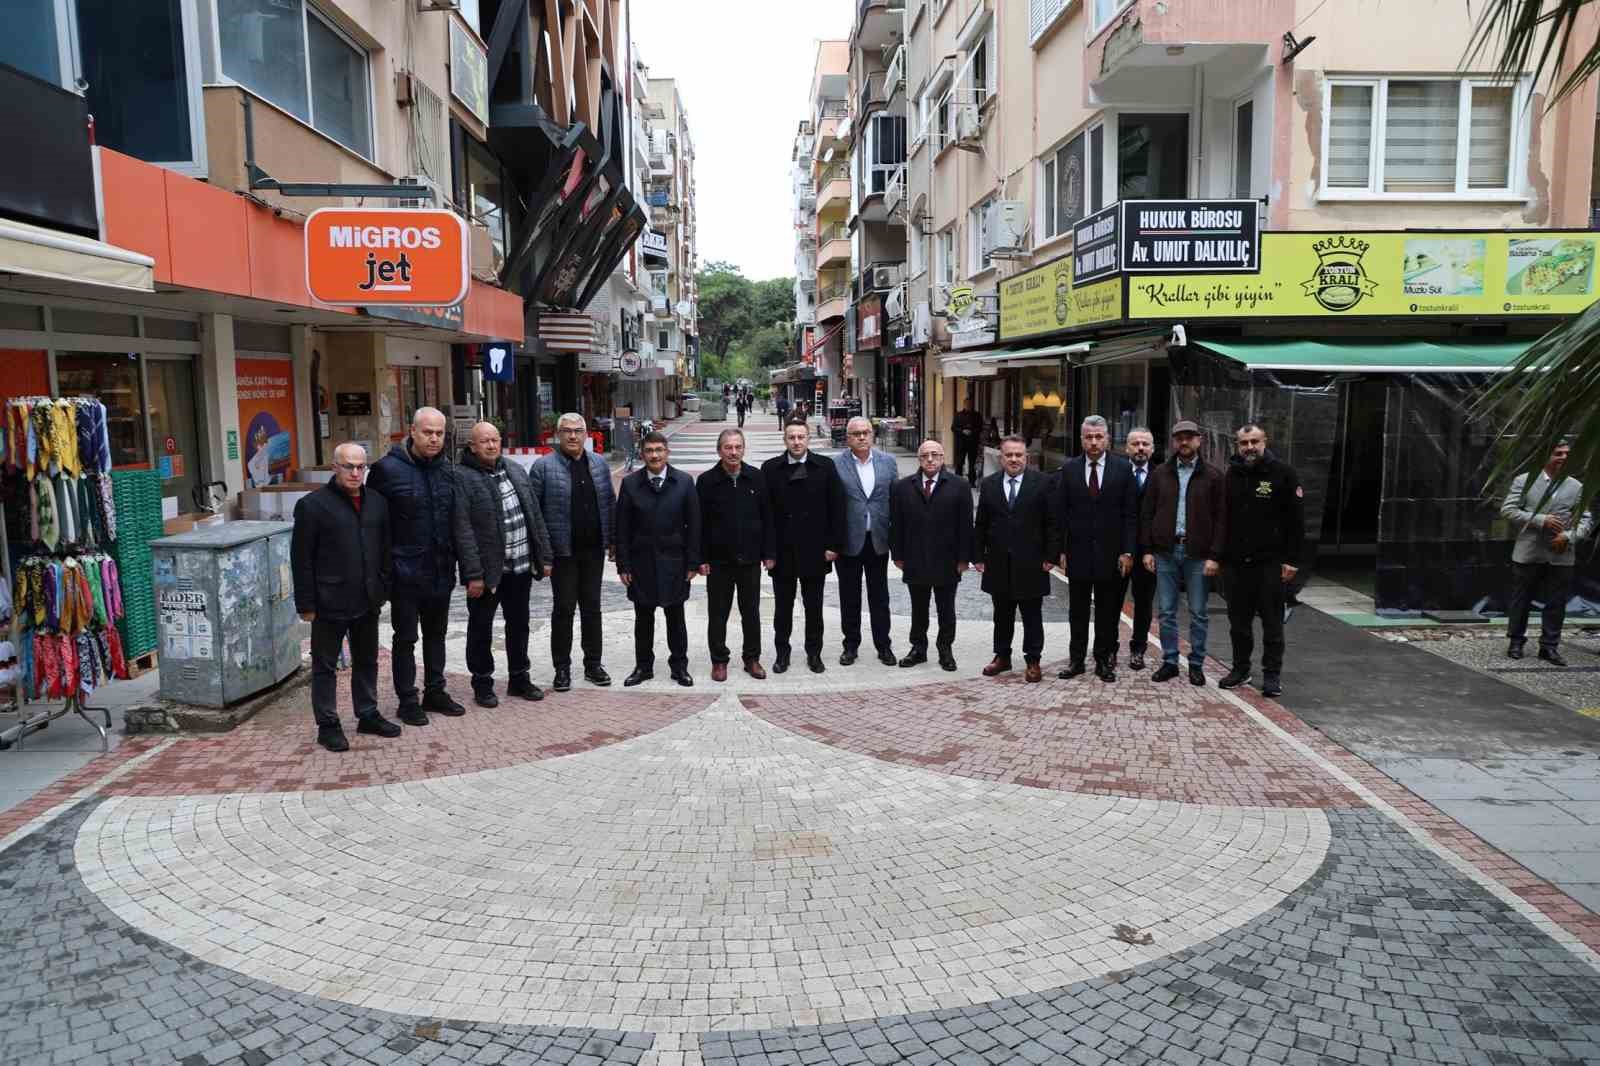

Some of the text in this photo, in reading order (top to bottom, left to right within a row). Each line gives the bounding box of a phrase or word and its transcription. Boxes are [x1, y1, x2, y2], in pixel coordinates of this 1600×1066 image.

[1140, 207, 1242, 228] HUKUK BÜROSU
[1132, 240, 1250, 267] Av. UMUT DALKILIÇ
[358, 252, 412, 290] jet
[1324, 266, 1357, 274] TOSTUN
